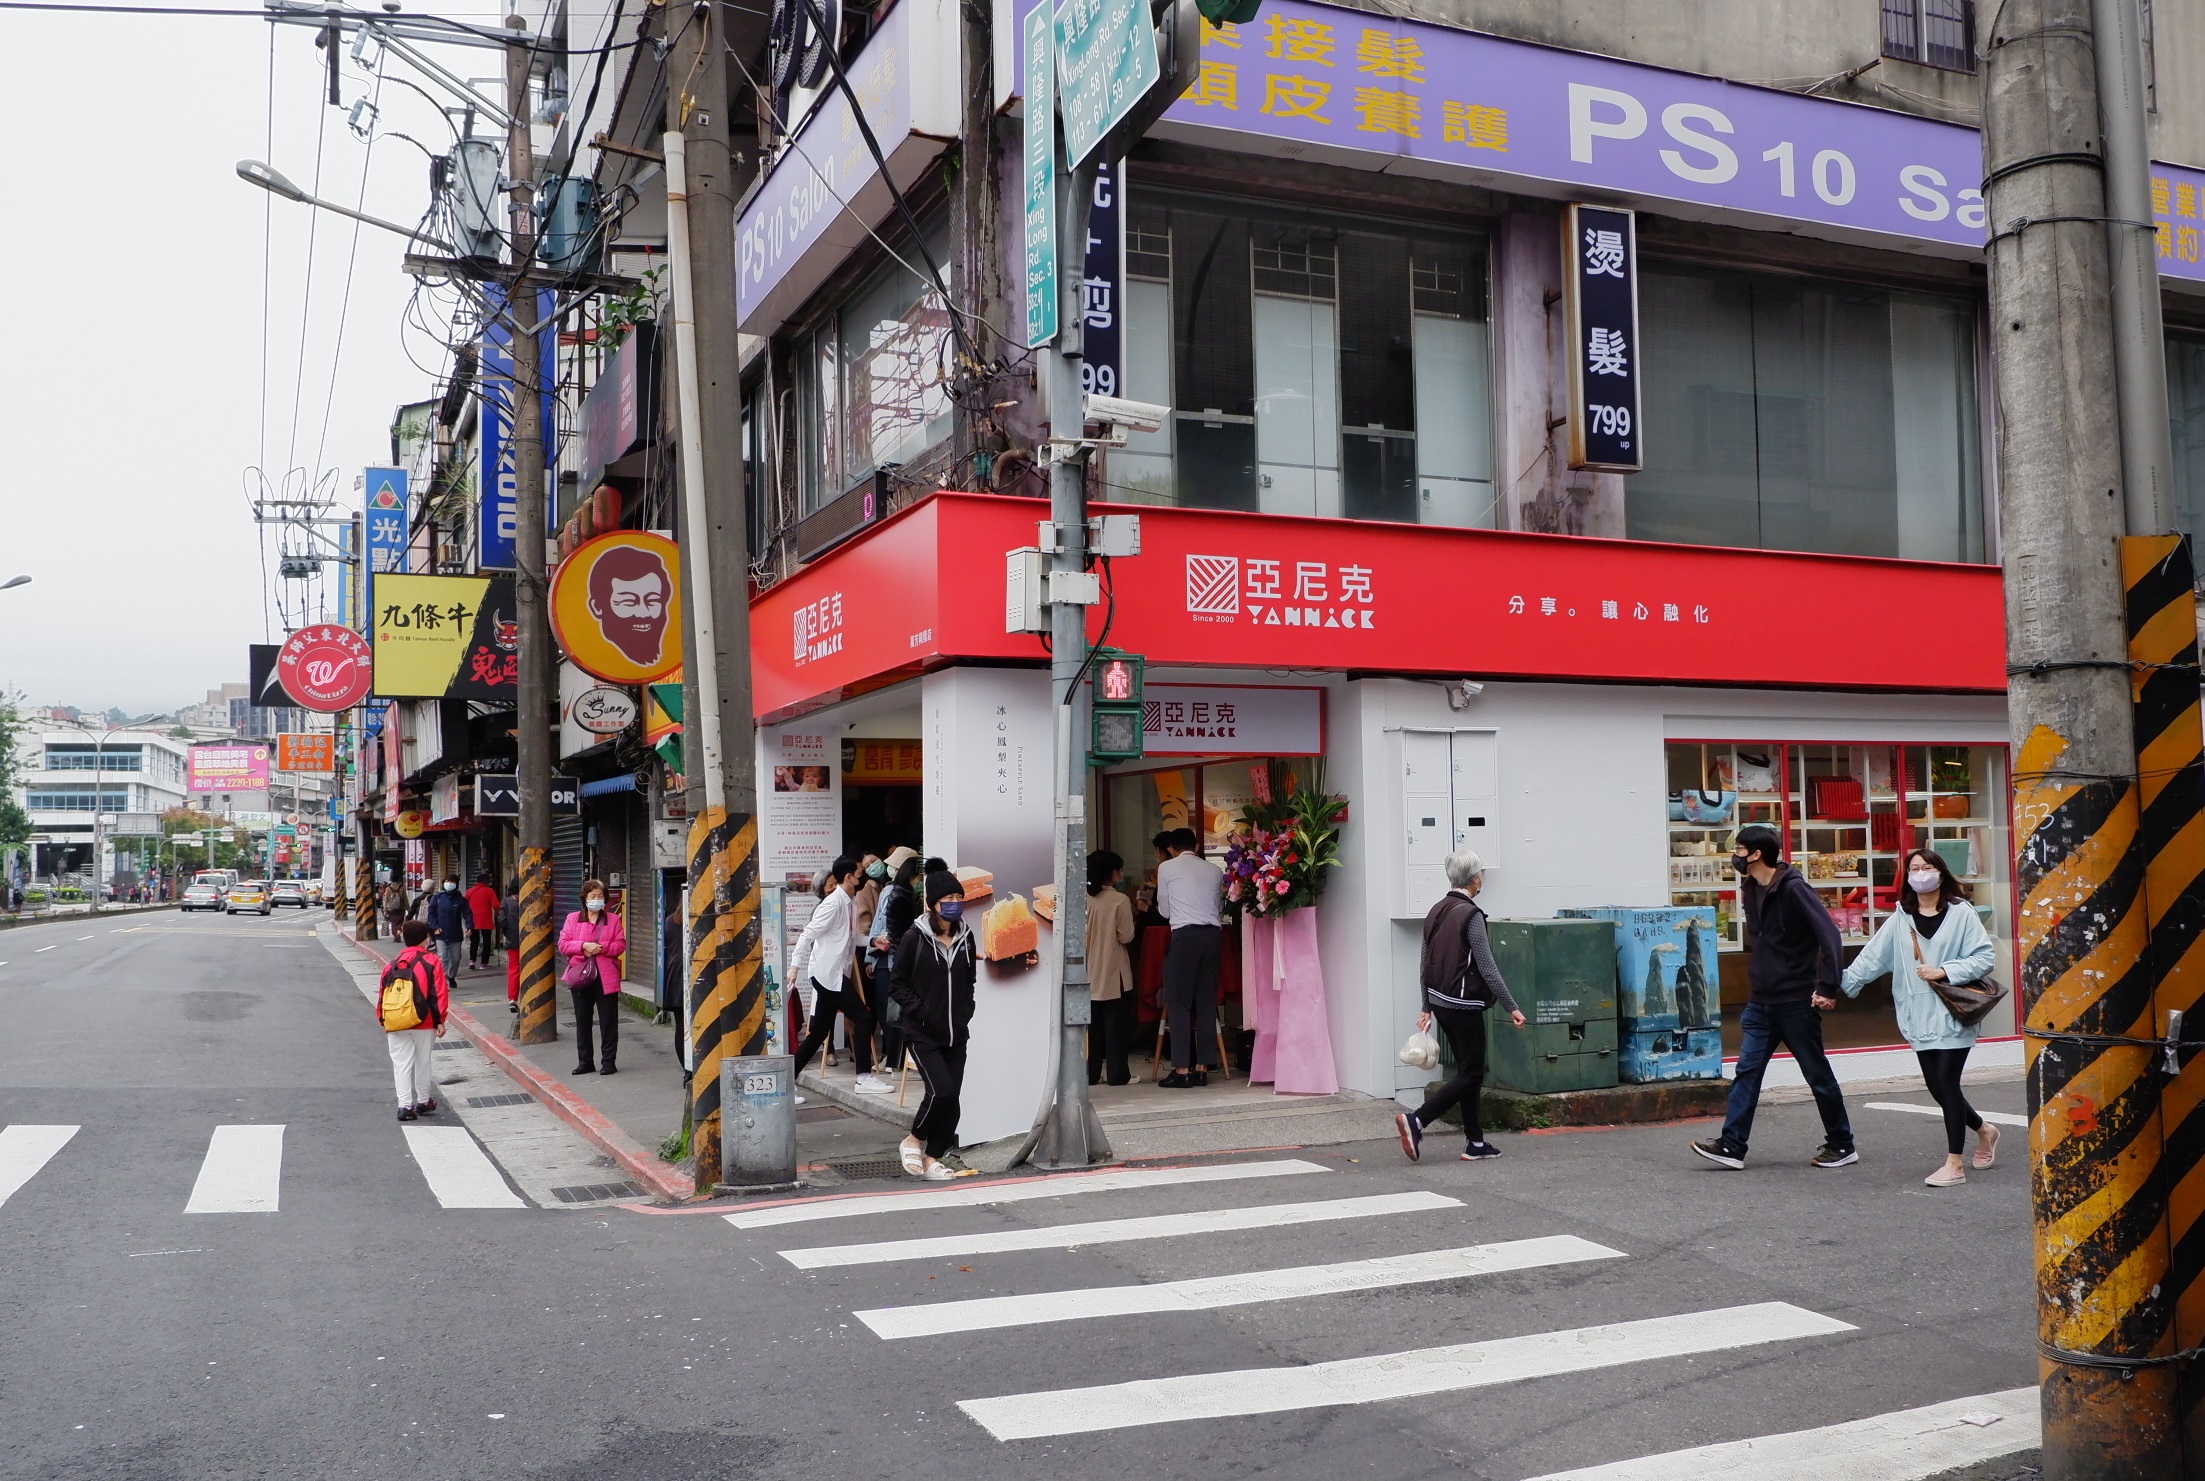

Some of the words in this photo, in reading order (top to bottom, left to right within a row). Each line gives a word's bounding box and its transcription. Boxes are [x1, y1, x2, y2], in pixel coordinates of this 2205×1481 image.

[1067, 41, 1100, 87] XingLong
[1099, 24, 1113, 48] Rd.
[1112, 7, 1130, 30] Sec.
[1128, 24, 1140, 51] 12
[1068, 91, 1082, 121] 108
[1090, 71, 1100, 97] 58
[1112, 78, 1123, 105] 59
[1135, 56, 1142, 80] 5
[1032, 36, 1046, 202] 興隆路三段
[1072, 120, 1085, 148] 113
[1093, 99, 1104, 124] 61
[1568, 82, 1739, 185] PS
[1762, 141, 1856, 207] 10
[1027, 207, 1045, 227] Xing
[2151, 177, 2205, 220] 營業
[741, 211, 764, 301] PS
[767, 205, 783, 267] 10
[790, 154, 835, 242] Salon
[1028, 226, 1048, 247] Long
[2153, 221, 2205, 264] 預約
[1029, 249, 1041, 269] Rd.
[1029, 269, 1045, 288] Sec.
[1047, 261, 1052, 277] 3
[1585, 227, 1628, 378] 燙髮
[1589, 404, 1631, 437] 799
[1620, 440, 1630, 450] up
[371, 517, 402, 573] 光點
[1245, 558, 1374, 603] 亞尼克
[380, 602, 474, 639] 九條牛
[807, 591, 843, 640] 亞尼克
[1192, 614, 1213, 623] Since
[1216, 615, 1235, 623] 2000
[583, 702, 629, 720] Sunny
[1164, 702, 1236, 724] 亞尼克
[996, 705, 1007, 794] 冰心鳳梨夾心
[746, 1077, 773, 1092] 323
